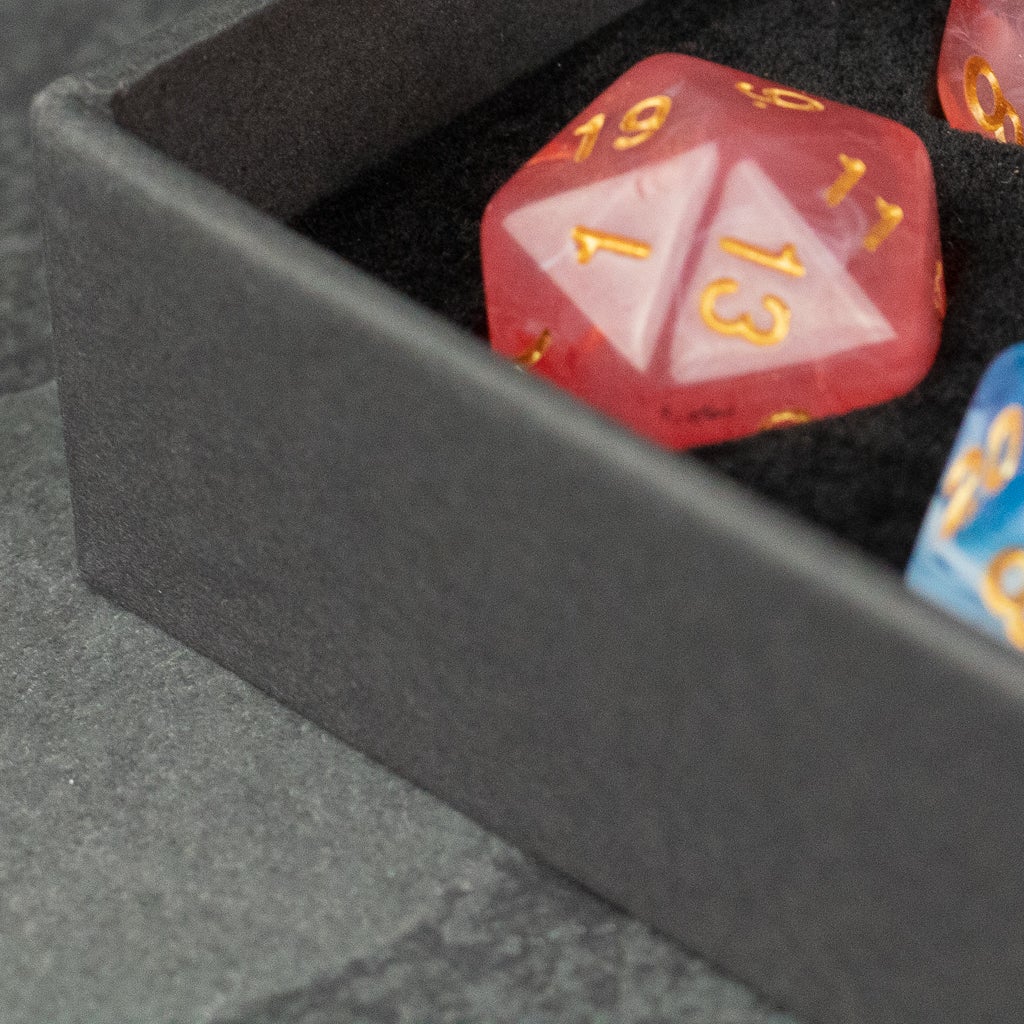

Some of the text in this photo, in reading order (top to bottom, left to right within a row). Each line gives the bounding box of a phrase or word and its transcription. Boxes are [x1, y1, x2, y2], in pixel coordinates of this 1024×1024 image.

[573, 94, 673, 164] 19
[571, 225, 652, 265] 1
[822, 152, 904, 254] 11
[700, 237, 806, 347] 13
